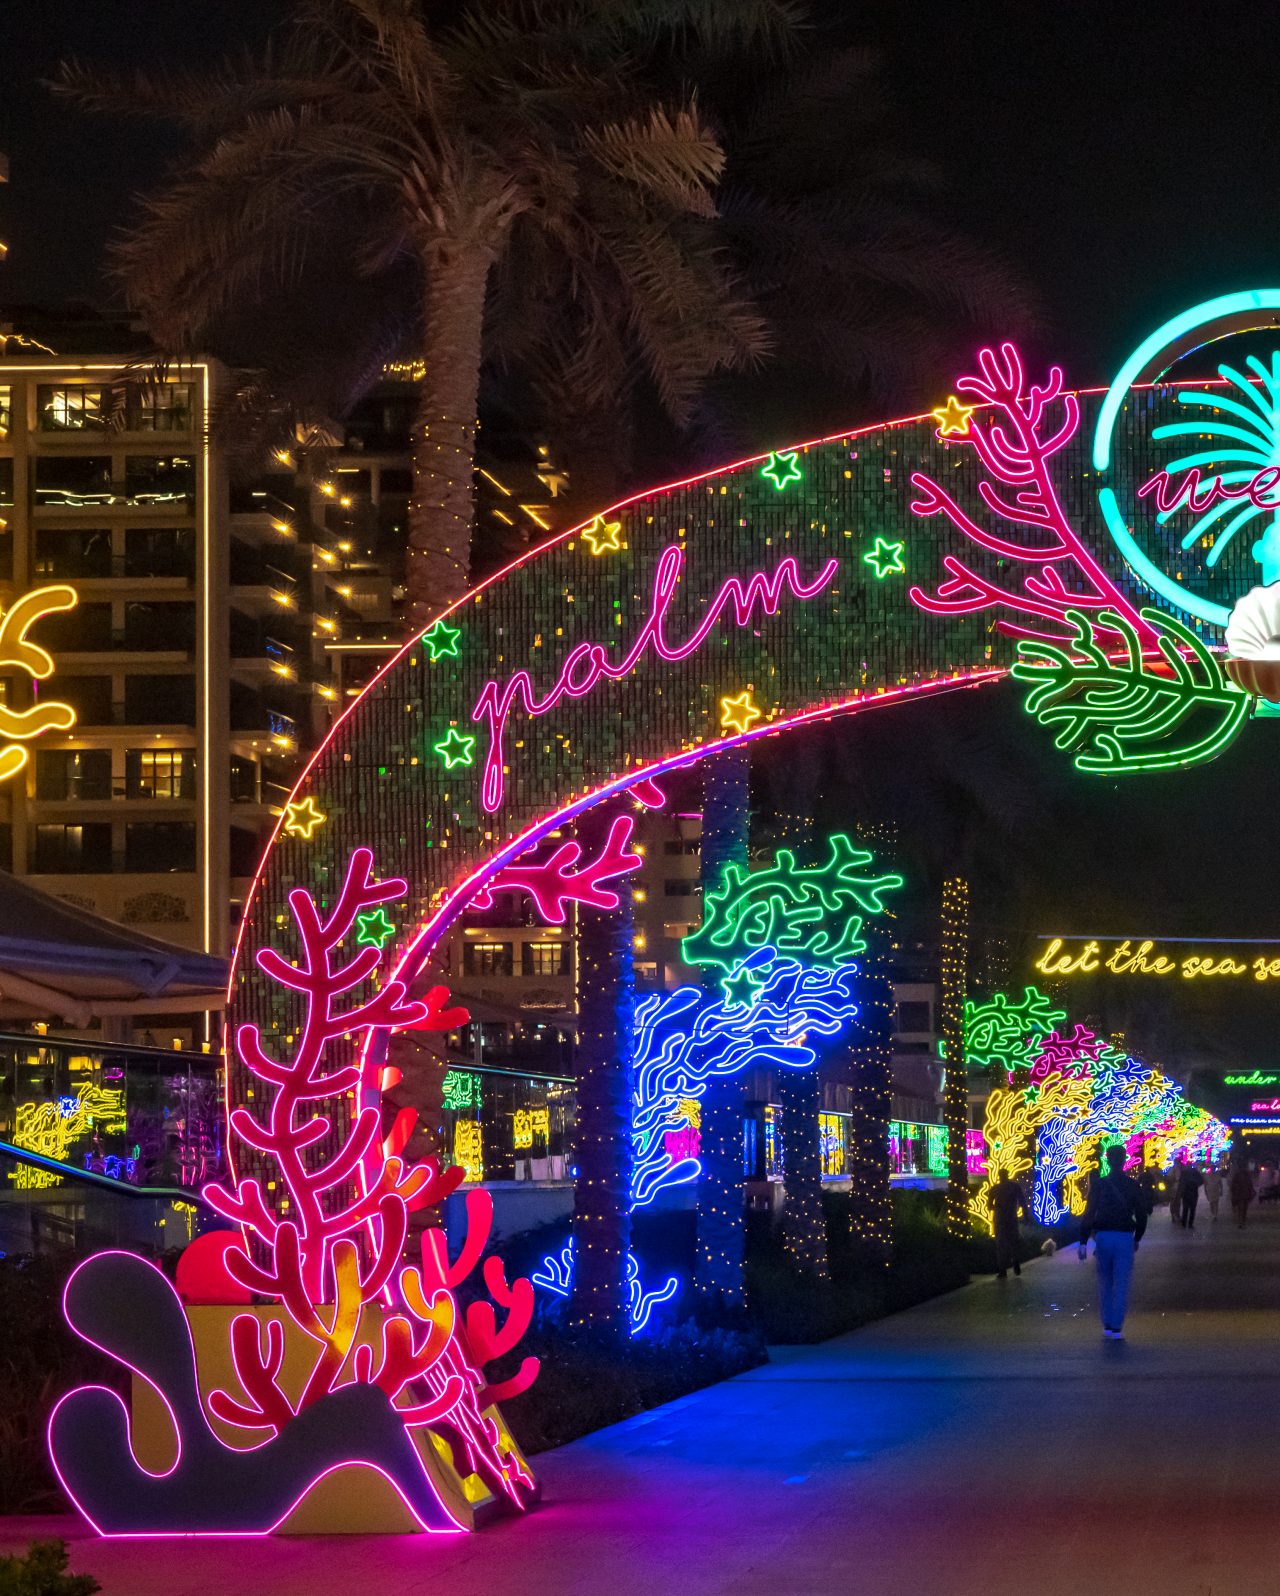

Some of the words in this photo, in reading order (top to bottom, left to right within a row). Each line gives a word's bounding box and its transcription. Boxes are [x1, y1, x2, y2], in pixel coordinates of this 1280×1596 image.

[472, 545, 839, 812] palm
[1036, 938, 1100, 974] let
[1105, 939, 1176, 974] the
[1181, 956, 1247, 978] sea
[1224, 1070, 1277, 1085] under
